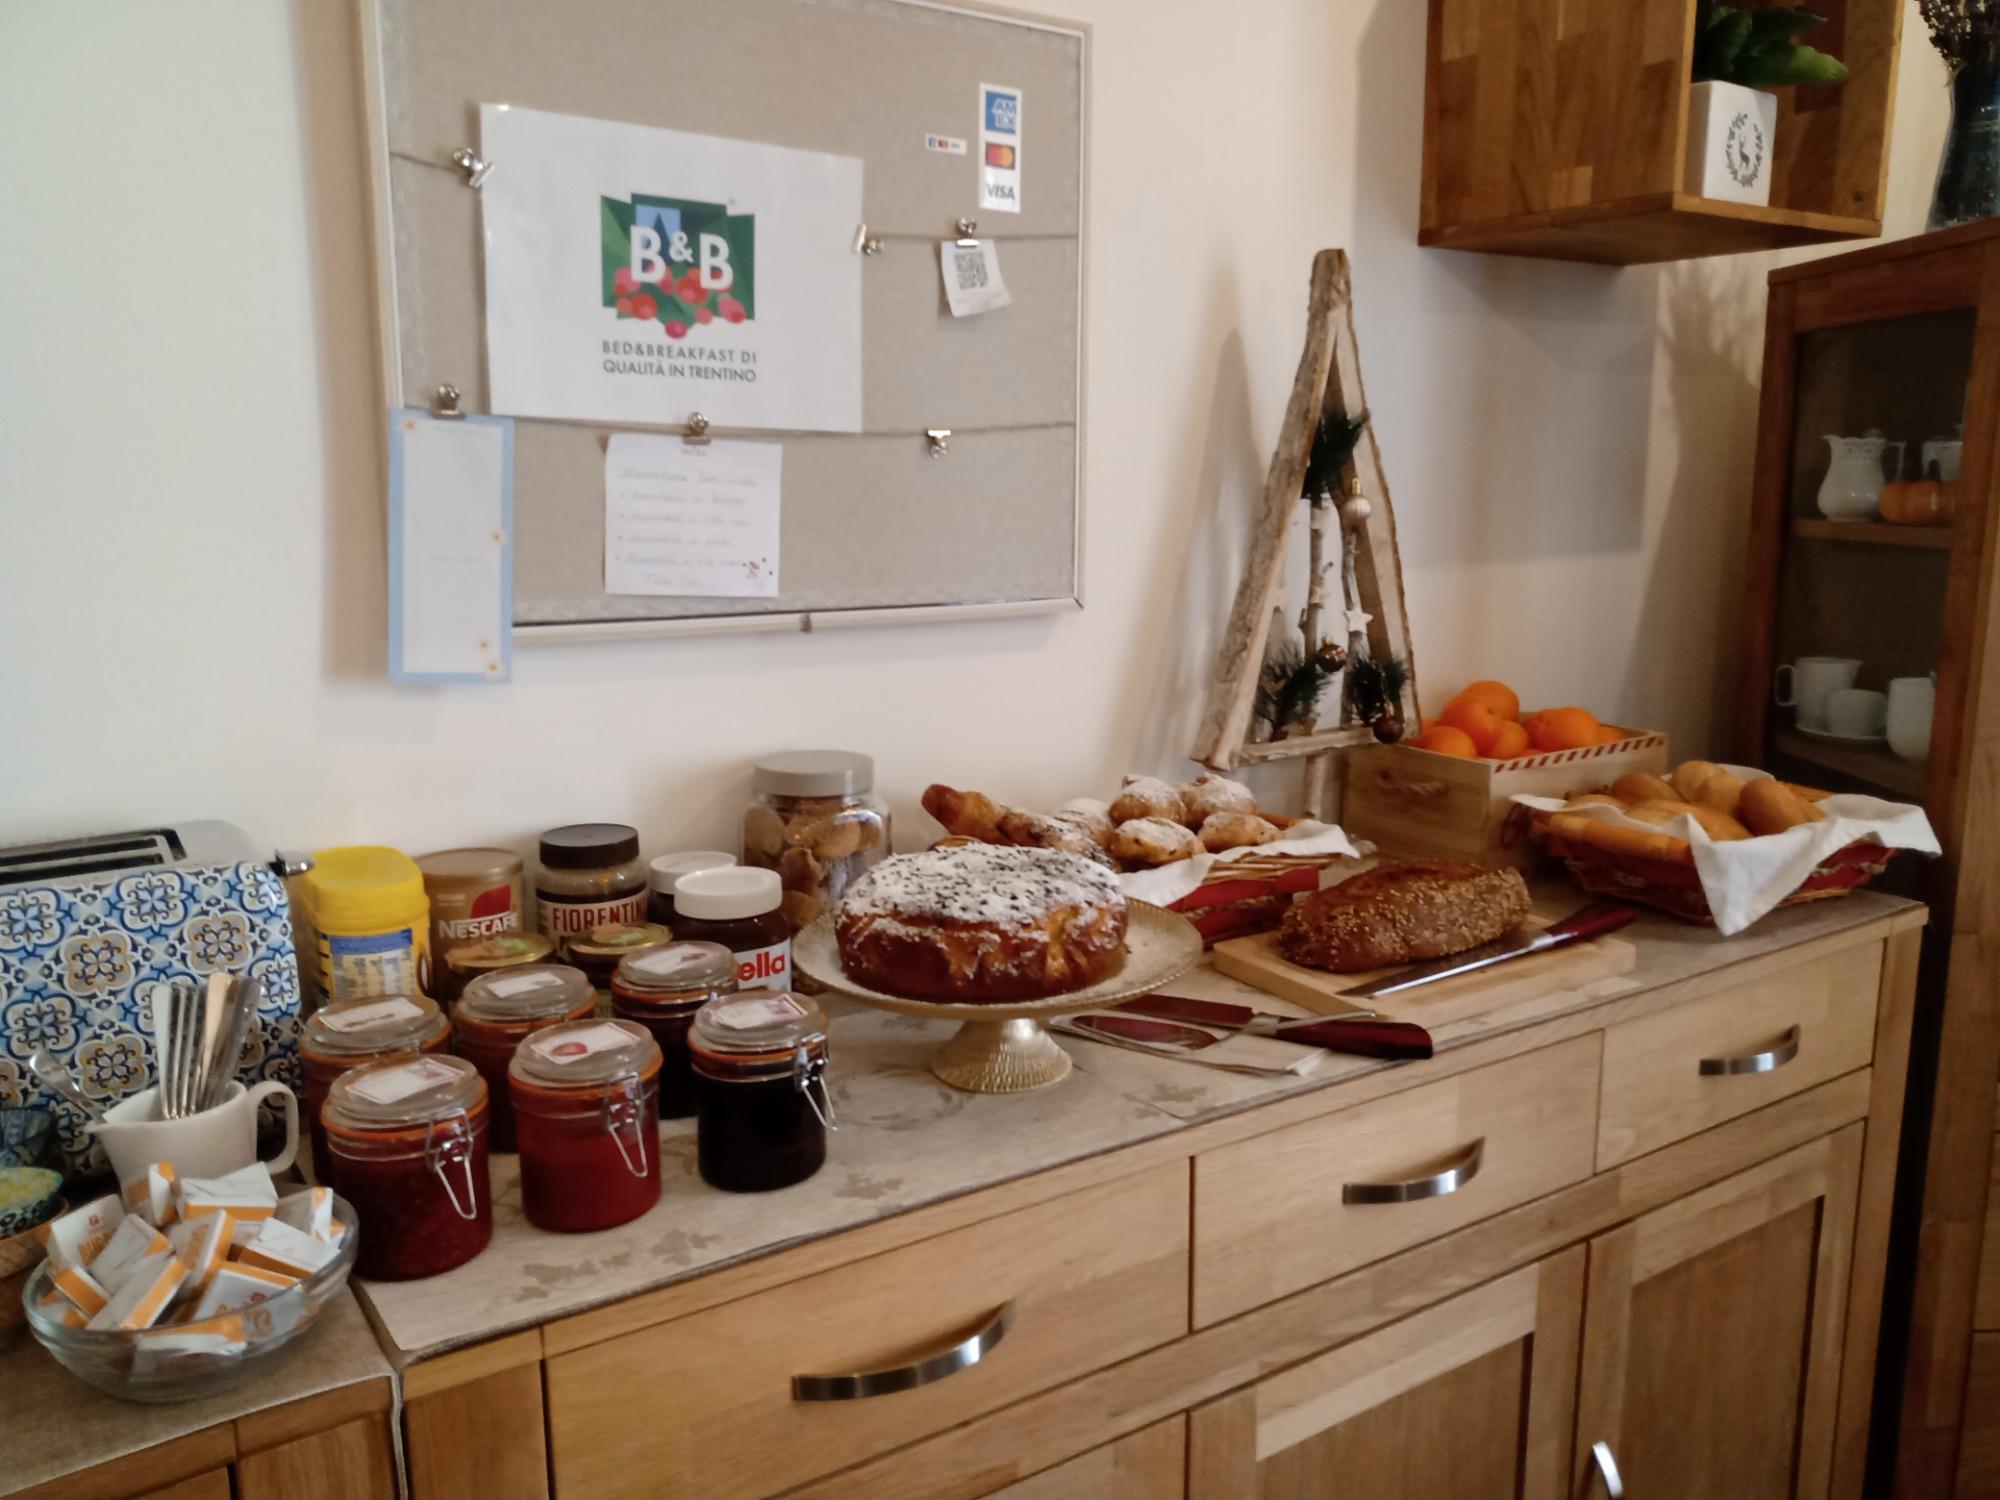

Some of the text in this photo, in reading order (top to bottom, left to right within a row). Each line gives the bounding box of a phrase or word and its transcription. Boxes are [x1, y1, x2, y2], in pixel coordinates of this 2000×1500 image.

[986, 183, 1015, 201] VISA
[601, 340, 757, 364] BED&BREAKFAST DI
[602, 358, 757, 383] QUALITÀ IN TRENTINO
[738, 950, 786, 982] ella
